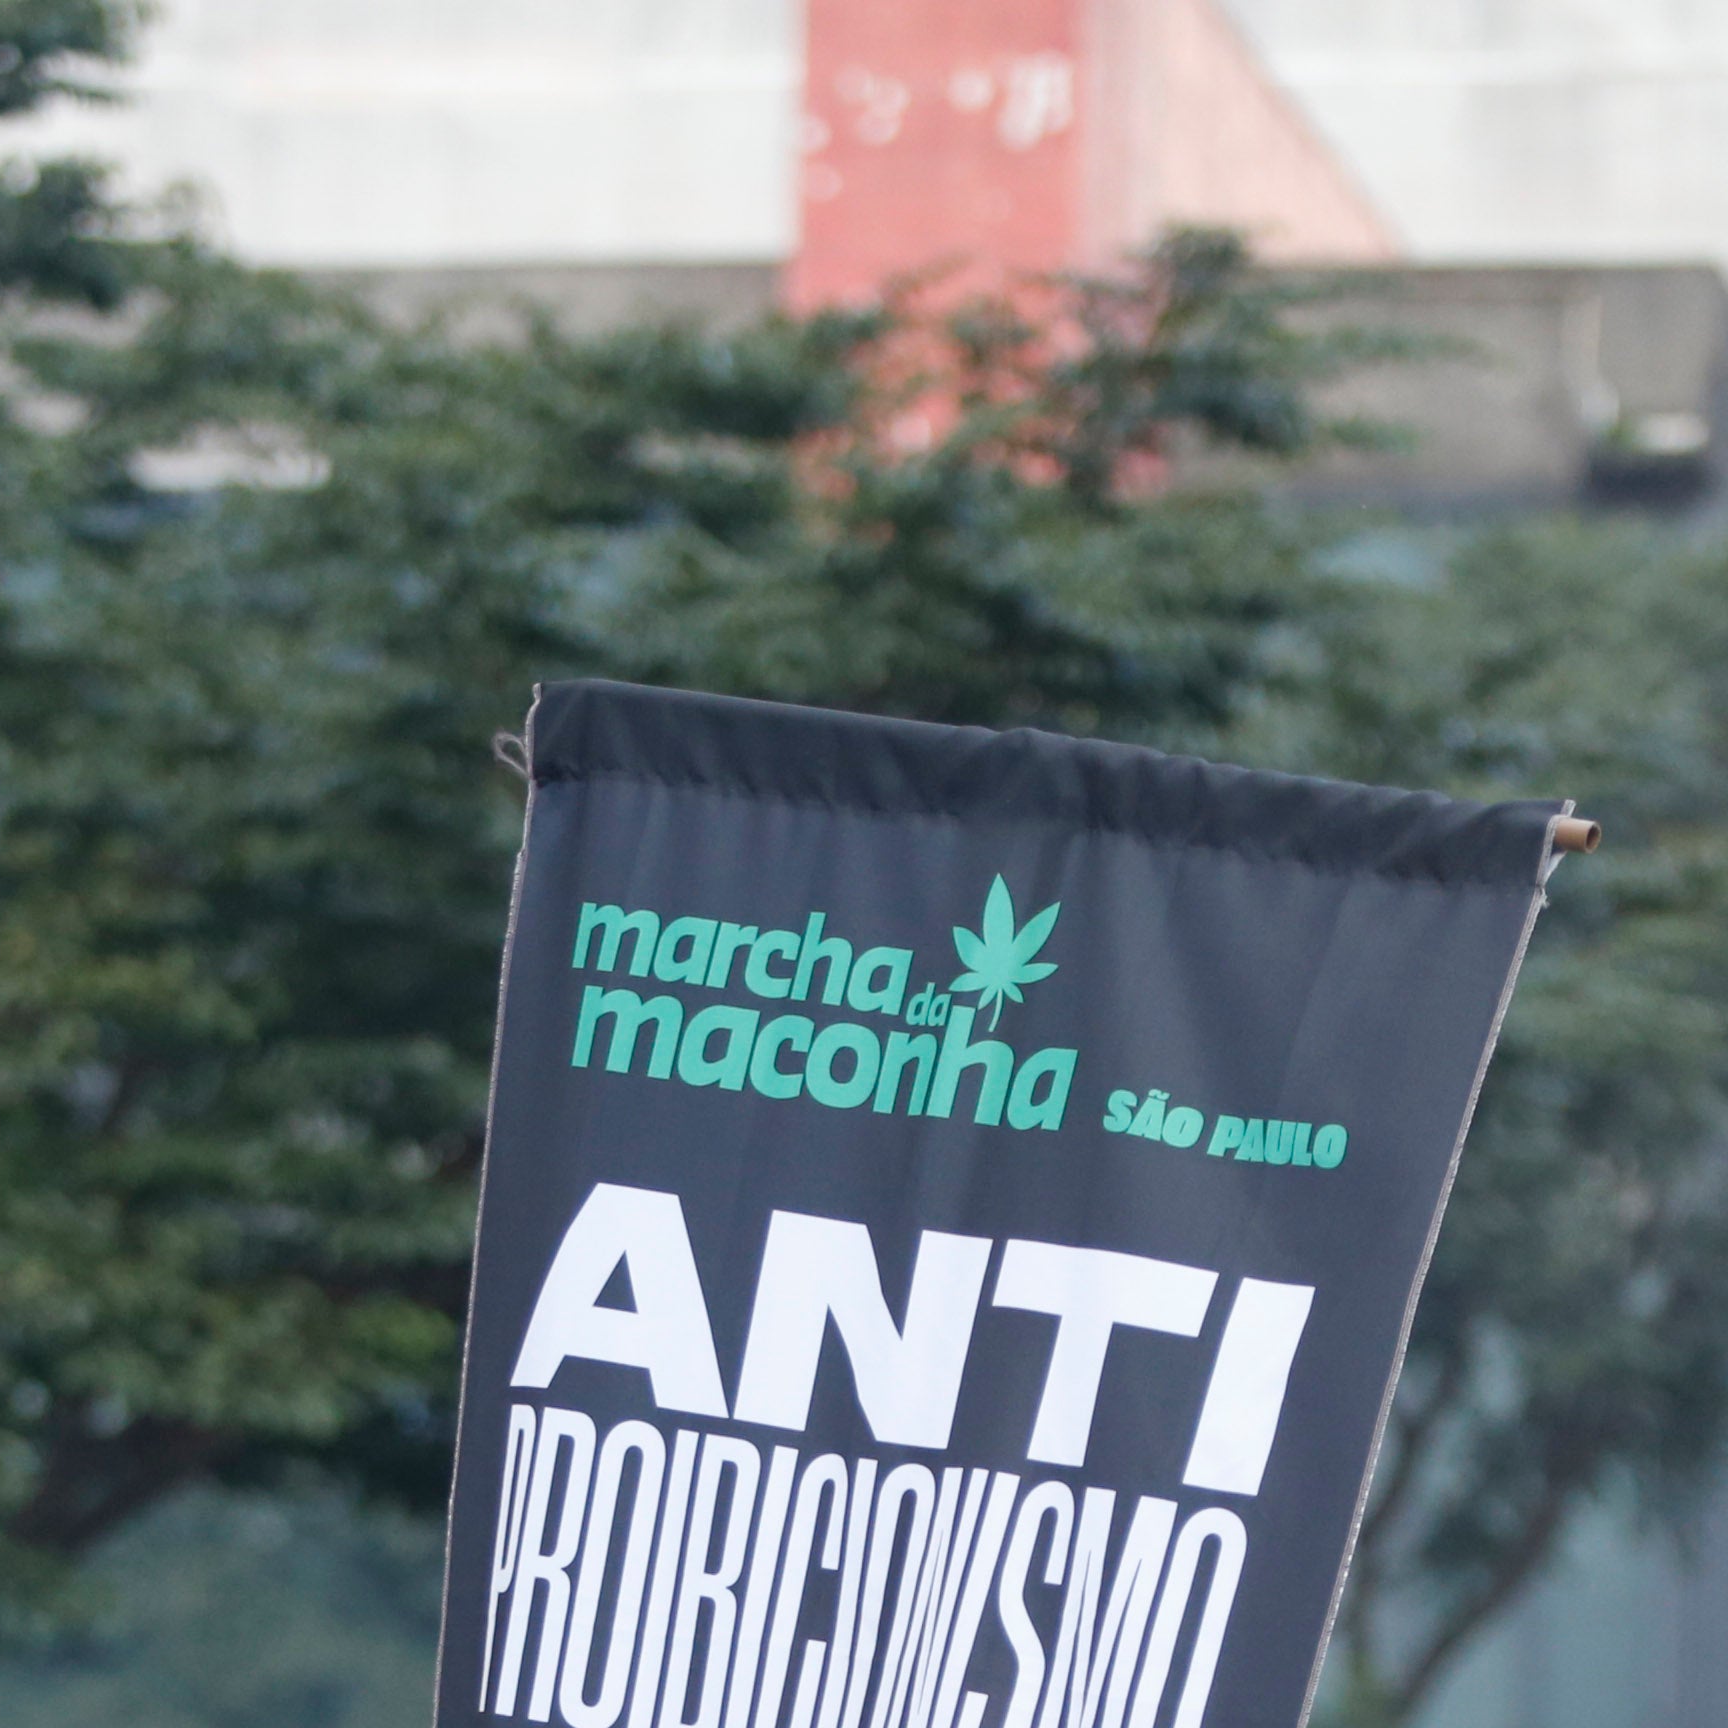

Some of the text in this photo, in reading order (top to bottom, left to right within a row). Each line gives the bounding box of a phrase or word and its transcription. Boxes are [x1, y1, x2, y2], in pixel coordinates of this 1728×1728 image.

[571, 901, 952, 1027] marcha da
[570, 984, 1348, 1170] maconha SÃO PAULO
[510, 1182, 1316, 1496] ANTI
